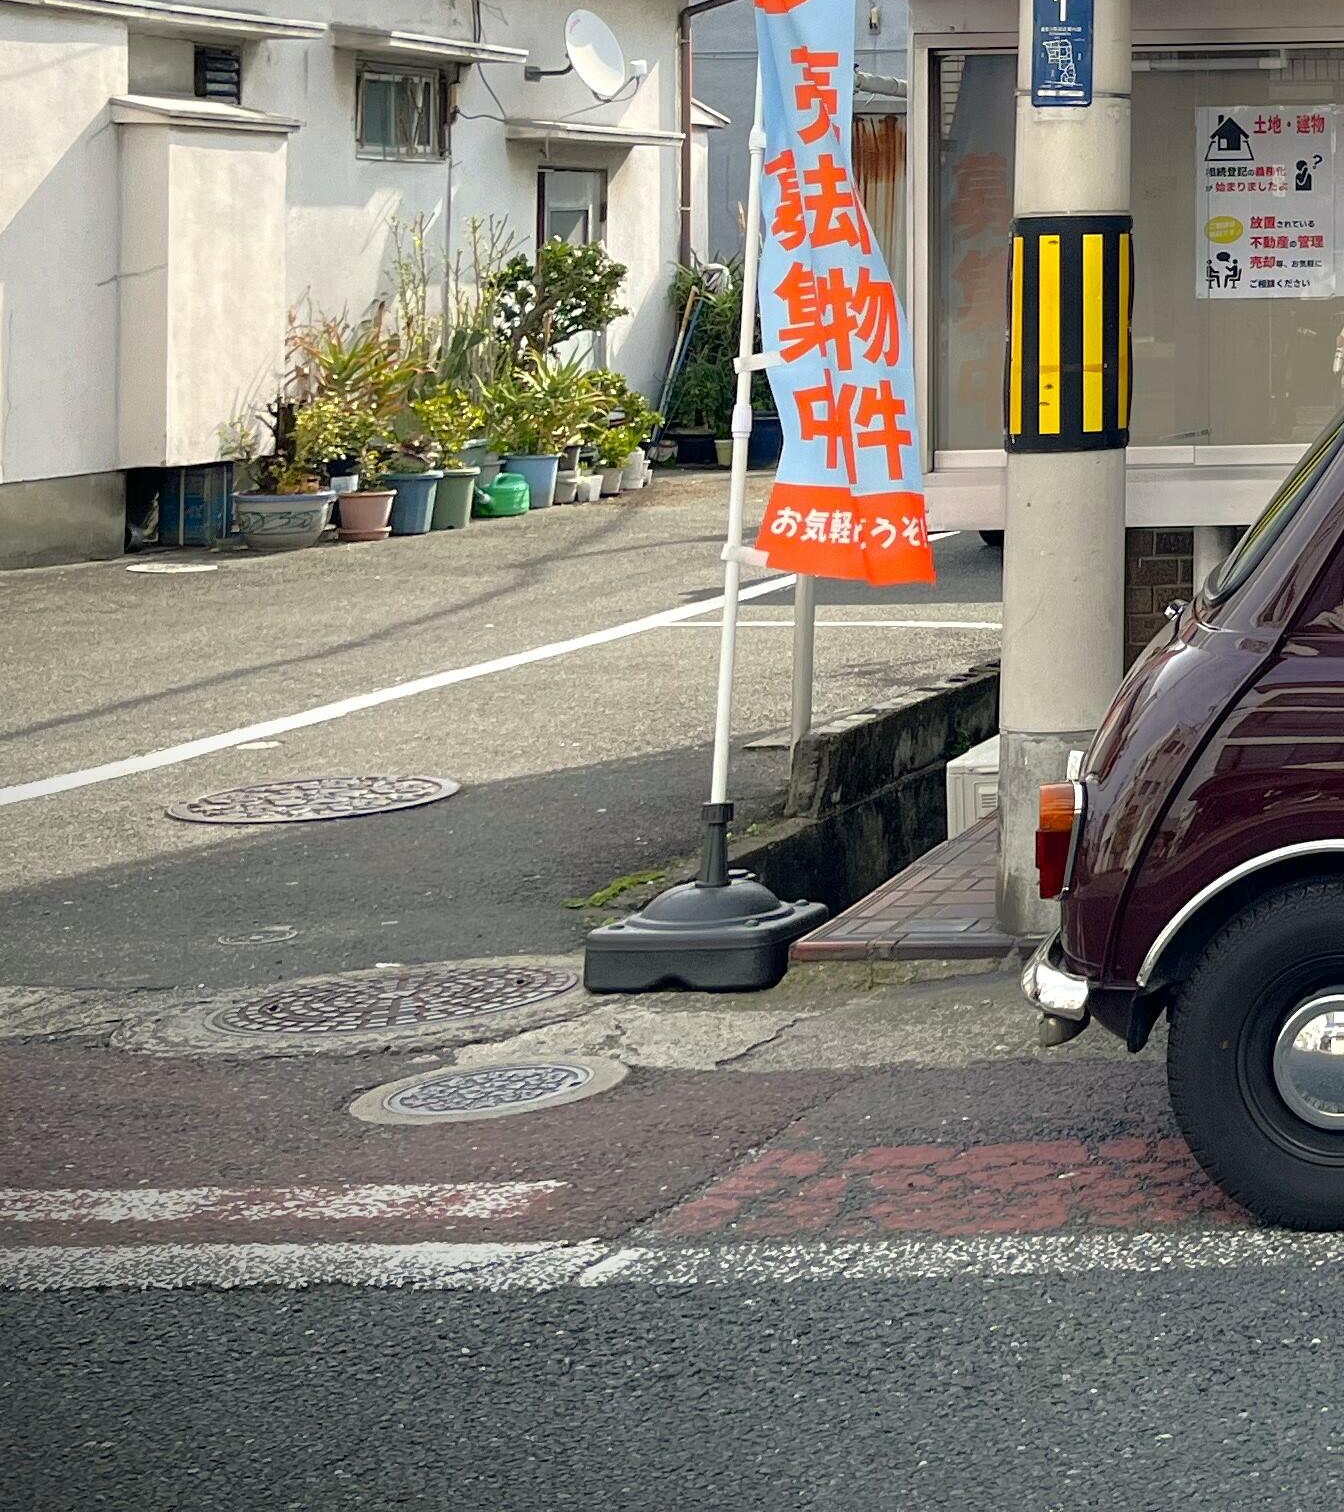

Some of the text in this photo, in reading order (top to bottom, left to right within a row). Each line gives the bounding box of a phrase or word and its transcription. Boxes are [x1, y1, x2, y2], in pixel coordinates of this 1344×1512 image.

[1253, 114, 1326, 135] 土地・建物
[1250, 216, 1315, 229] 放置されている
[1250, 235, 1325, 249] 不動産の管理
